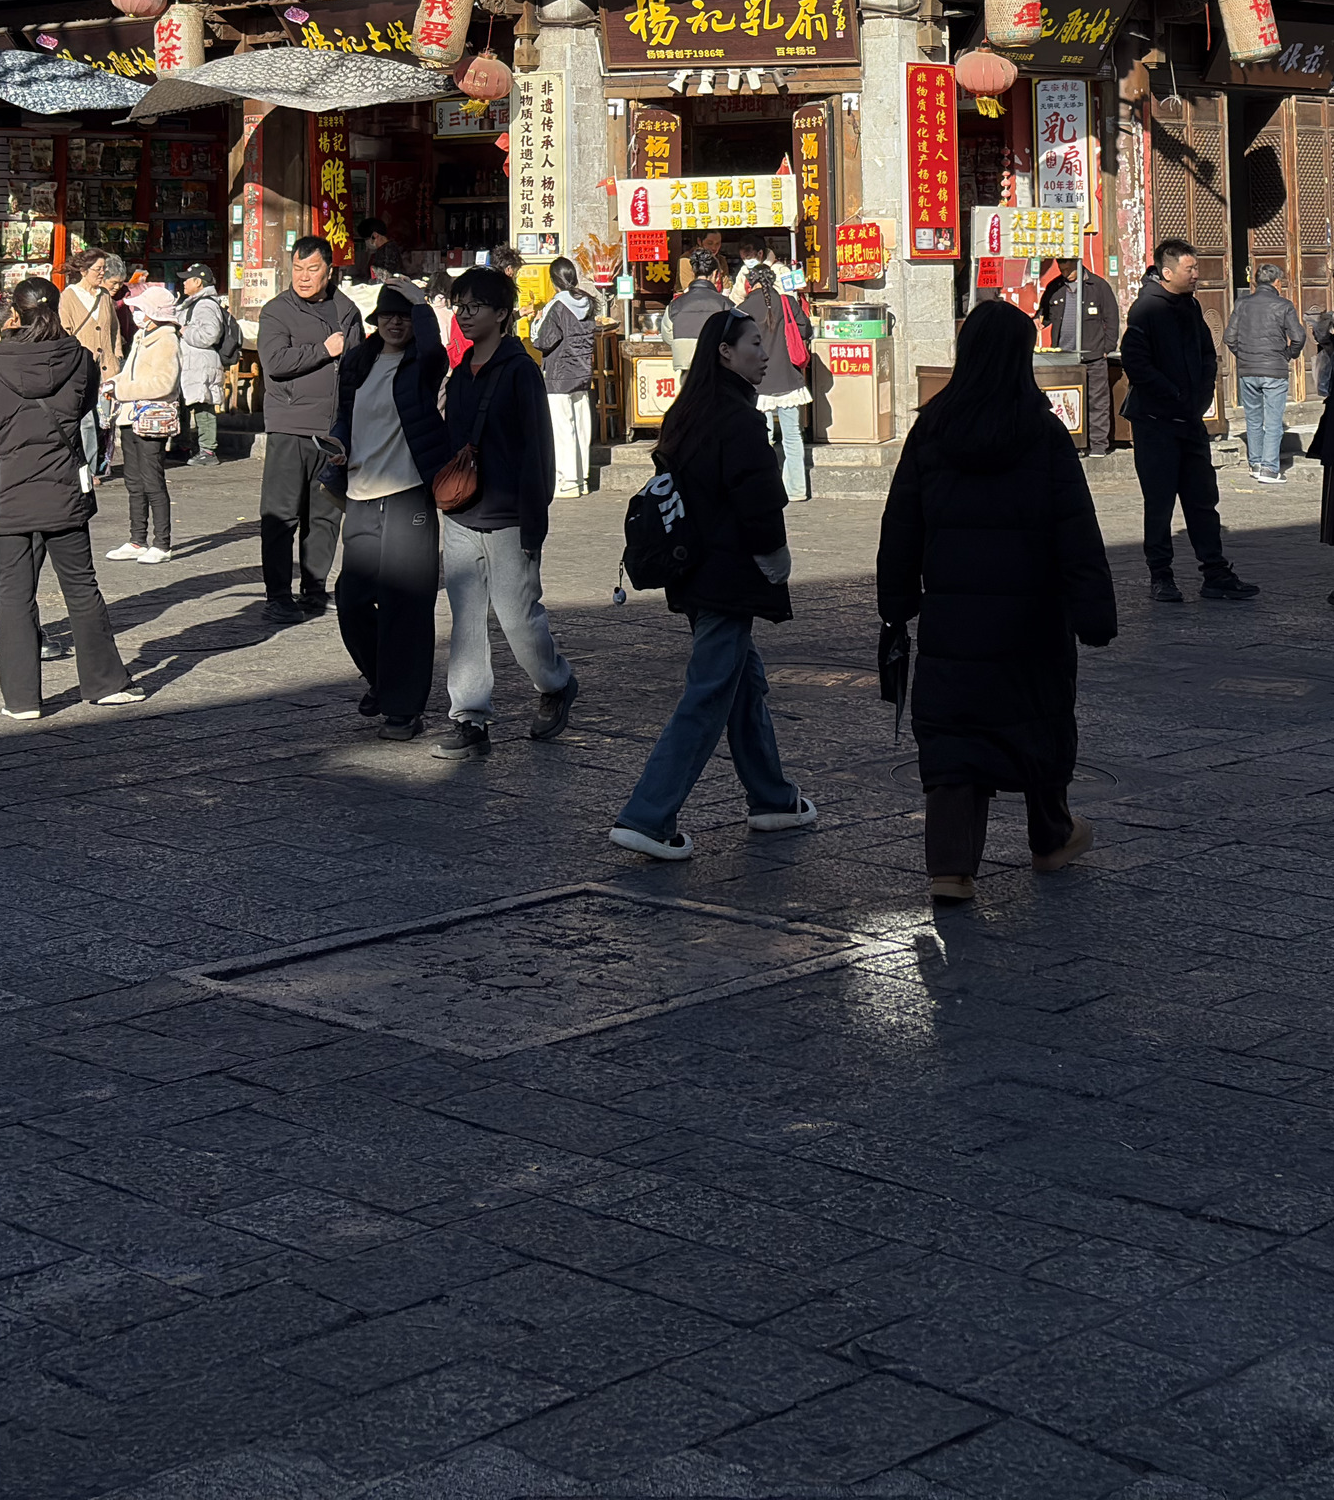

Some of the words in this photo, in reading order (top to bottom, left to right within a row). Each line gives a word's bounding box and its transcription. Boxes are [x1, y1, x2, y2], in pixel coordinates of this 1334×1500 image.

[155, 18, 184, 70] 饮茶
[646, 49, 725, 60] 杨锦香创于1986年
[775, 46, 817, 57] 百年杨记
[317, 115, 344, 127] 正宗老字号
[540, 79, 555, 169] 非遗传承人
[636, 119, 677, 133] 正宗老字号
[794, 115, 823, 130] 正宗老字号
[935, 75, 949, 162] 非遗传承人
[519, 81, 535, 229] 非物质文化遗产杨记乳扇
[916, 73, 931, 223] 非物质文化遗产杨记乳扇
[1040, 111, 1083, 177] 乳扇
[540, 175, 555, 229] 杨锦香
[670, 178, 756, 200] 大理杨记
[936, 170, 949, 223] 杨锦香
[1043, 180, 1084, 191] 40年老店
[1043, 193, 1084, 204] 厂家直销
[634, 189, 646, 224] 老字号
[801, 132, 821, 284] 杨记烤乳扇
[830, 360, 871, 373] 10元/份
[655, 378, 676, 398] 现
